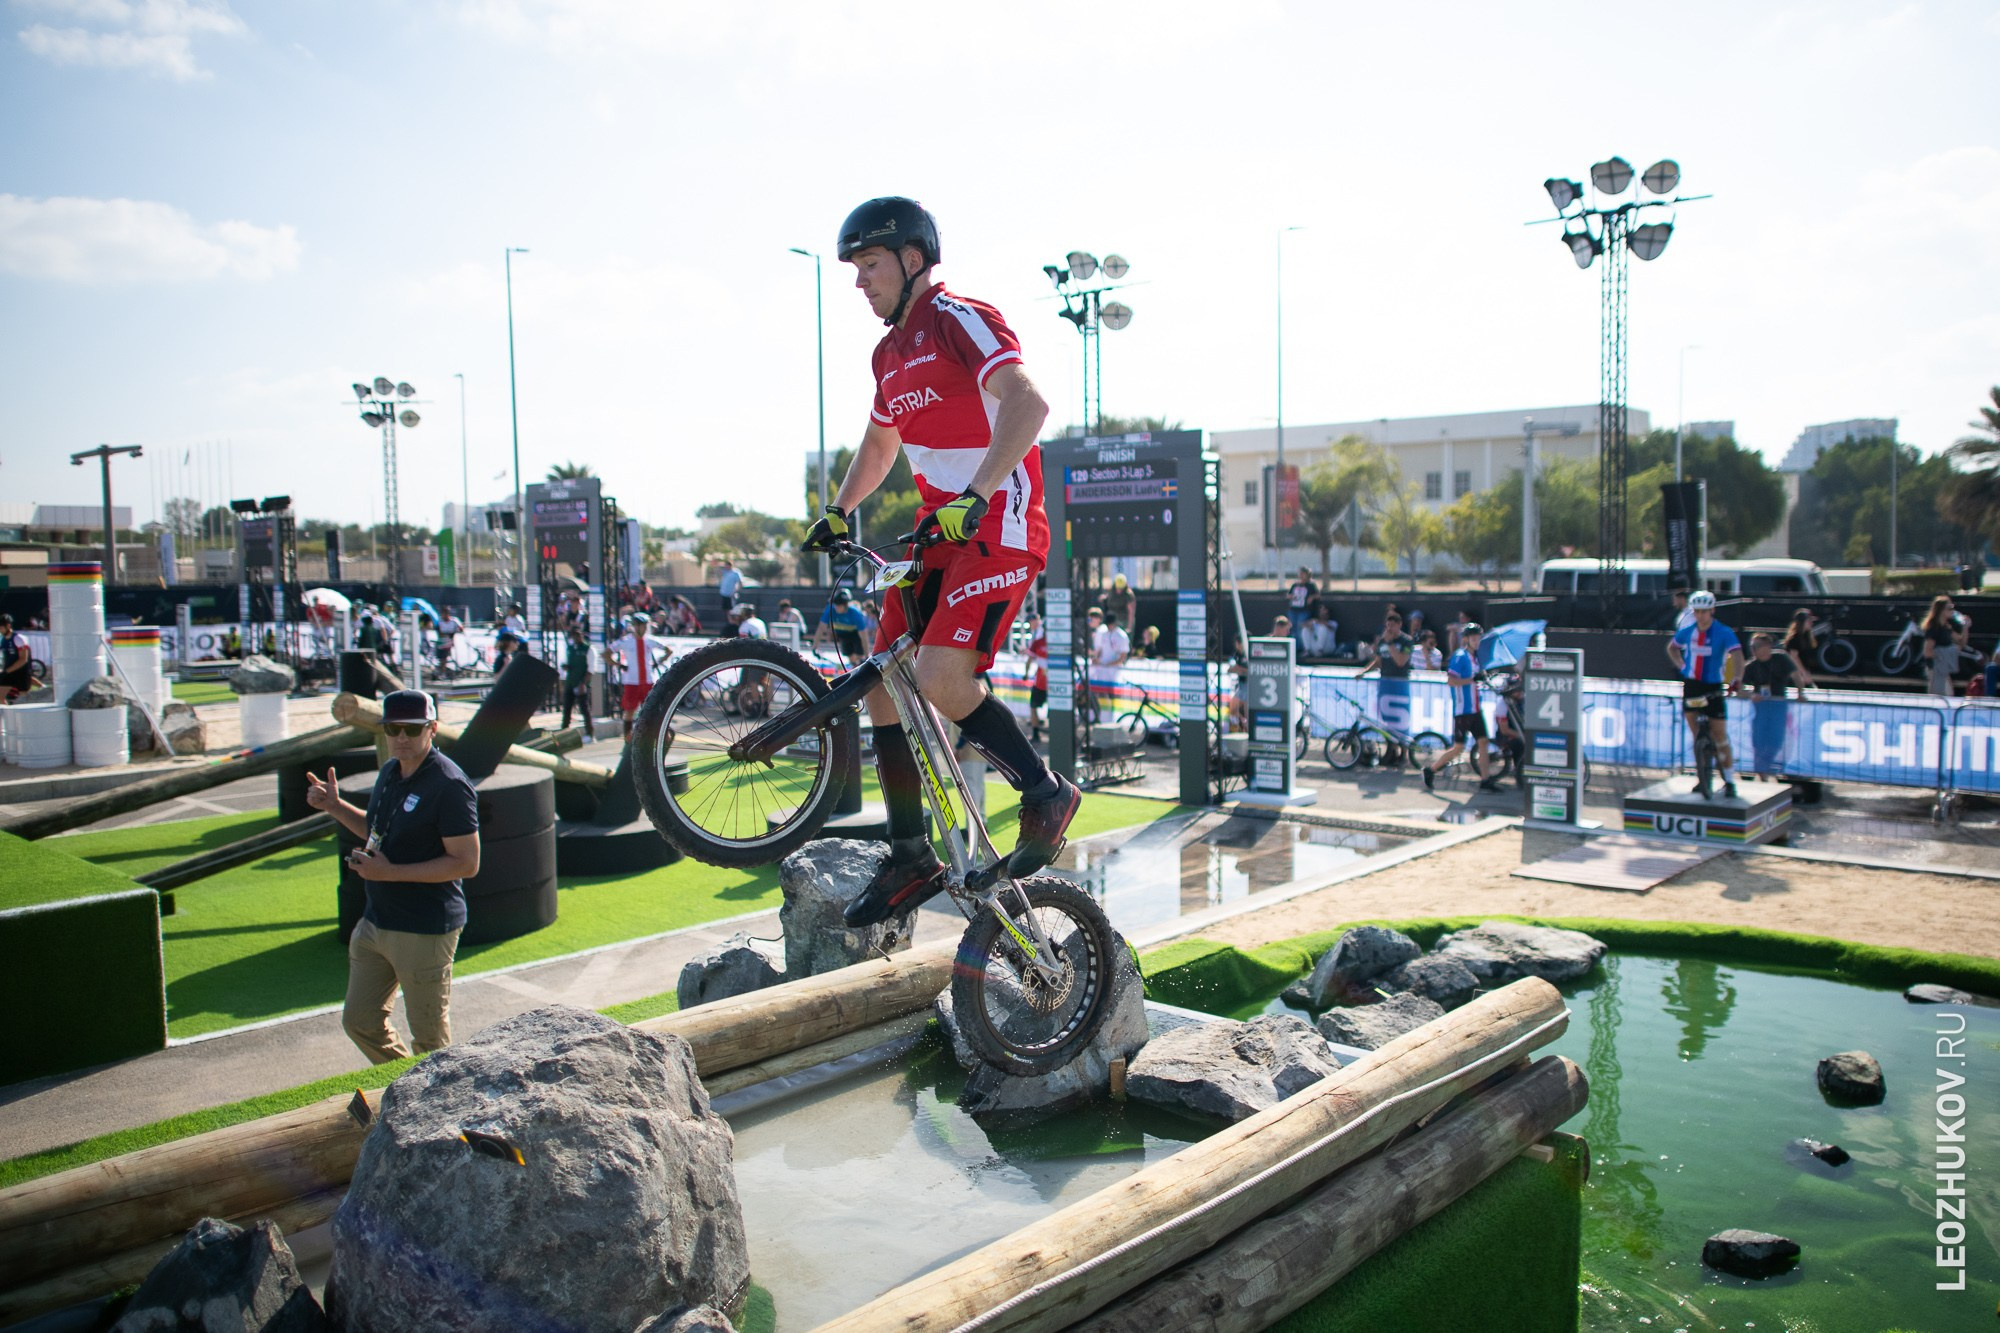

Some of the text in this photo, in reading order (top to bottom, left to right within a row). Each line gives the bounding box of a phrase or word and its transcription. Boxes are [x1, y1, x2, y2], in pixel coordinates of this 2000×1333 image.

[1098, 449, 1136, 463] FINISH
[1071, 470, 1088, 482] 120
[1074, 485, 1132, 498] ANDERSSON
[1163, 509, 1172, 525] 0
[947, 566, 1028, 608] COMAS
[1250, 664, 1289, 677] FINISH
[1259, 677, 1278, 707] 3
[1530, 677, 1574, 692] START
[1538, 693, 1564, 727] 4
[1656, 815, 1703, 836] UCI
